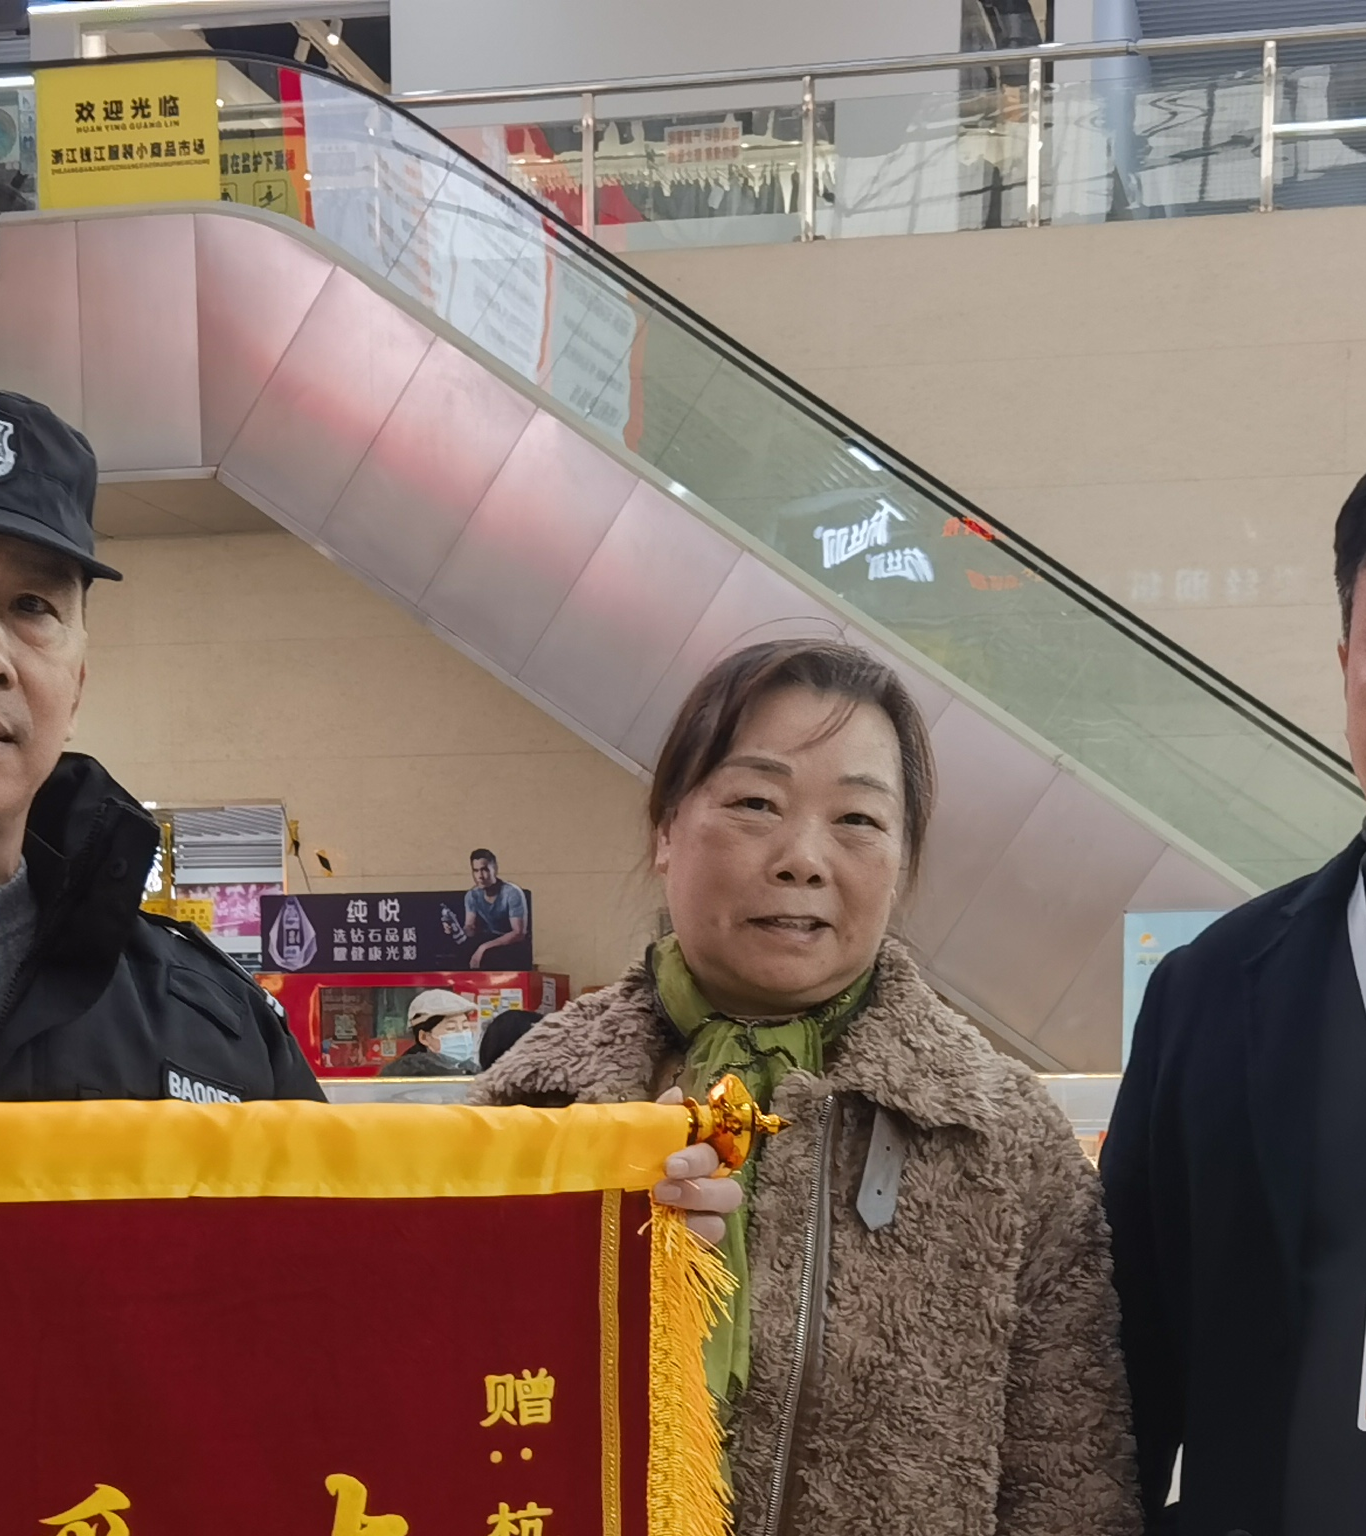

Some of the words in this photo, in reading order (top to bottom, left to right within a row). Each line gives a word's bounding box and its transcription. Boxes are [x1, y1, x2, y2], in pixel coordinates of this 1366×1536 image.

[75, 95, 180, 123] 欢迎光临
[76, 124, 103, 134] HUAN
[105, 123, 128, 133] YING
[130, 121, 163, 131] GUANG
[164, 119, 180, 129] LIN
[51, 138, 206, 165] 浙江钱江服装小商品市场
[346, 898, 401, 925] 纯悦
[333, 927, 418, 945] 选钻石品质
